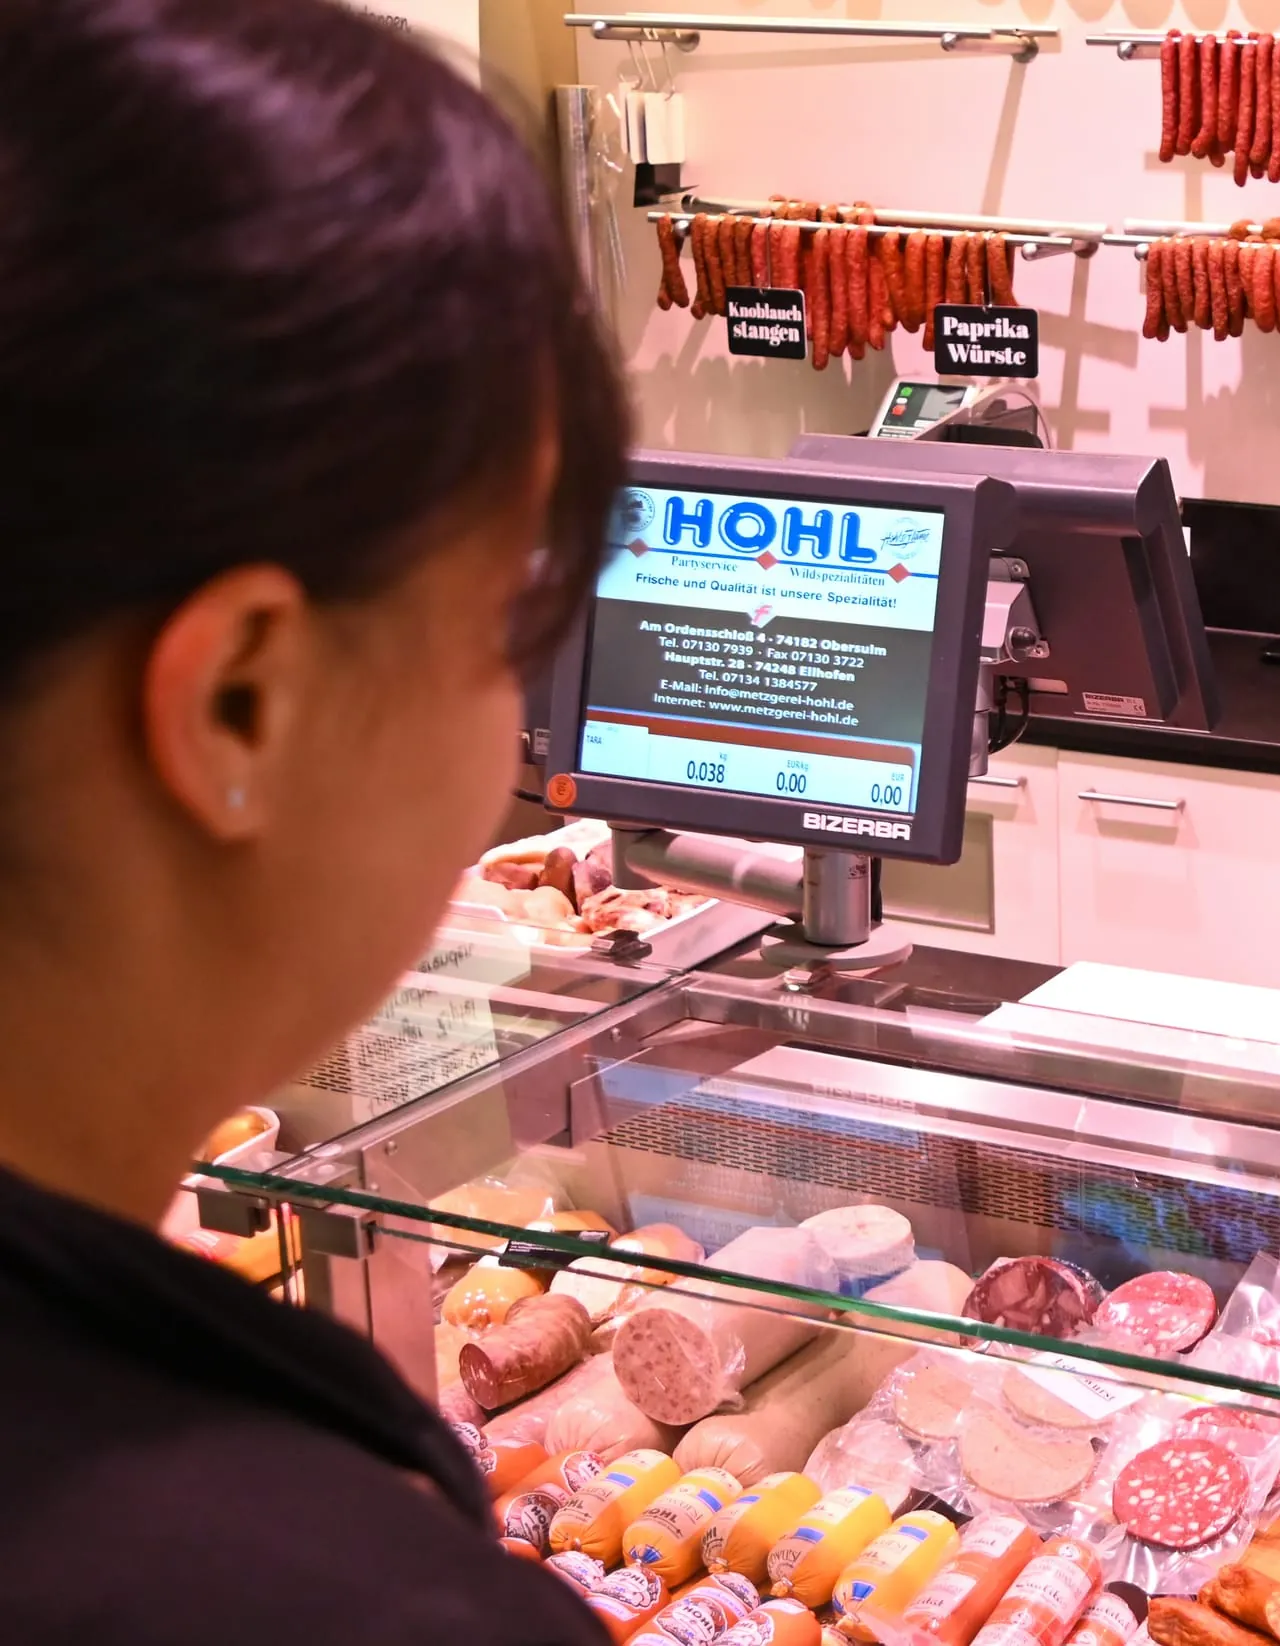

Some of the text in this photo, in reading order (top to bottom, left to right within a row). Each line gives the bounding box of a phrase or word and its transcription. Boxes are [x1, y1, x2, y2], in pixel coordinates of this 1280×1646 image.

[728, 301, 802, 321] Knoblauch
[733, 321, 800, 347] stangen
[942, 316, 1030, 342] Paprika
[946, 343, 1027, 365] Würste
[663, 496, 877, 564] HOHL
[671, 555, 738, 573] Partyservice
[790, 566, 886, 587] Wildspezialitäten
[635, 572, 898, 609] Frische und Qualität ist unsere Spezialität!
[640, 620, 662, 632] Am
[776, 634, 818, 649] 74182
[820, 639, 887, 656] Obersulm
[658, 636, 865, 668] Tel. 07130 7939 Fax 07130 3722
[664, 651, 726, 667] Hauptstr.
[727, 658, 745, 669] 28
[754, 661, 797, 675] 74248
[698, 668, 818, 692] Tel. 07134 1384577
[660, 679, 856, 711] E-Mail: info@metzgerei-hohl.de
[653, 693, 860, 727] Internet: www.metzgerei-hohl.de
[803, 812, 911, 841] BIZERBA
[614, 1570, 645, 1587] HOHL
[683, 1605, 714, 1635] HOHL
